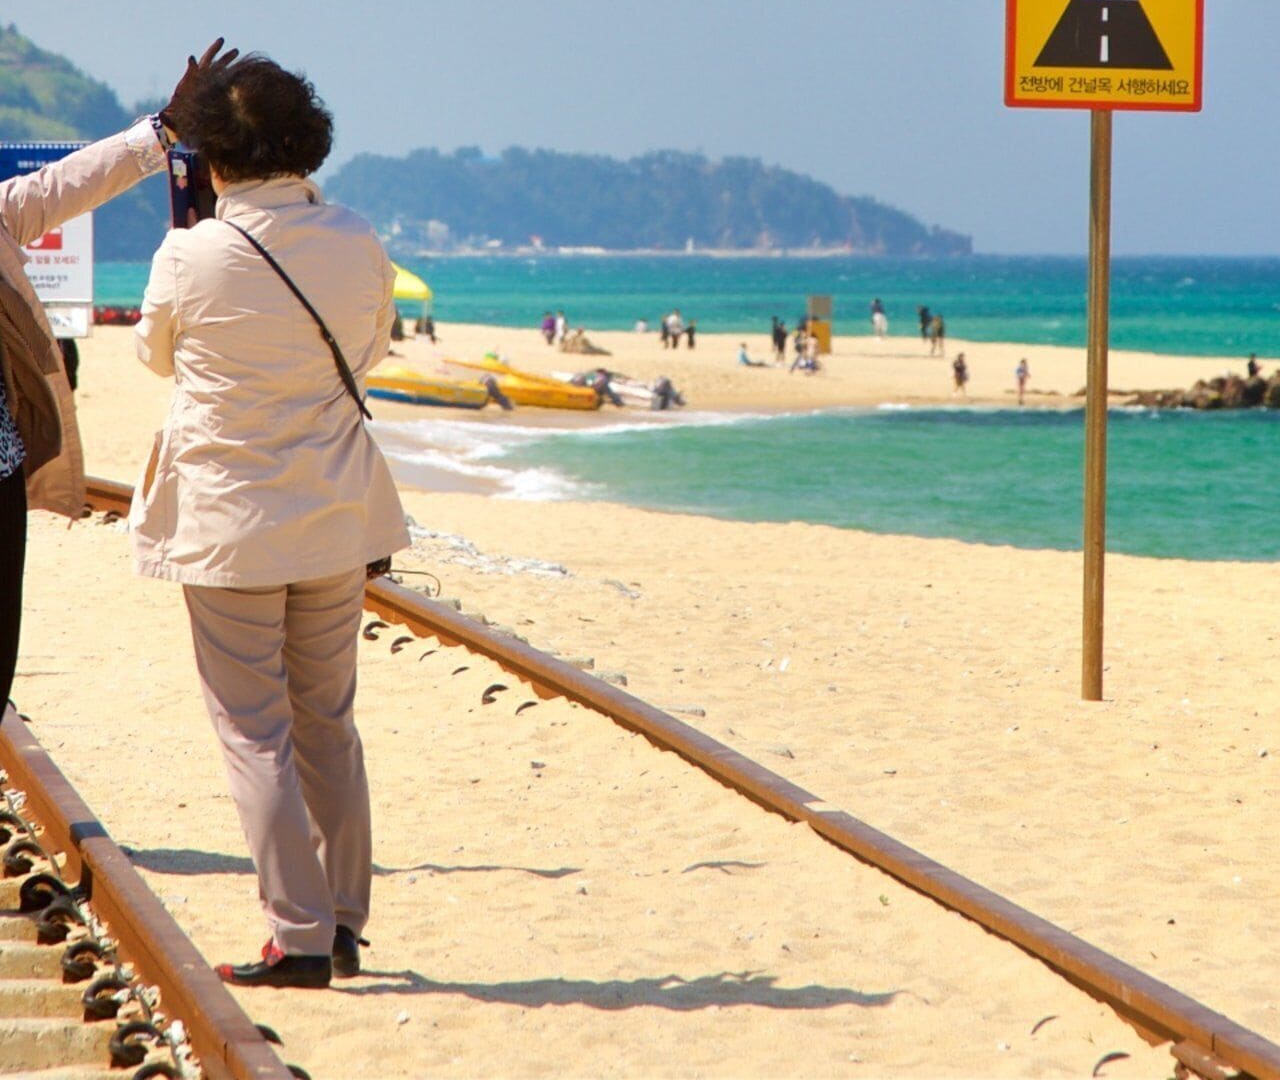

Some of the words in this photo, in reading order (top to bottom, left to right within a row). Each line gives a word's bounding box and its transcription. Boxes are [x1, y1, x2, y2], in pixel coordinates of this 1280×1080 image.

[1020, 76, 1064, 92] 전방에
[1069, 77, 1111, 93] 건널목
[1117, 78, 1190, 96] 서행하세요
